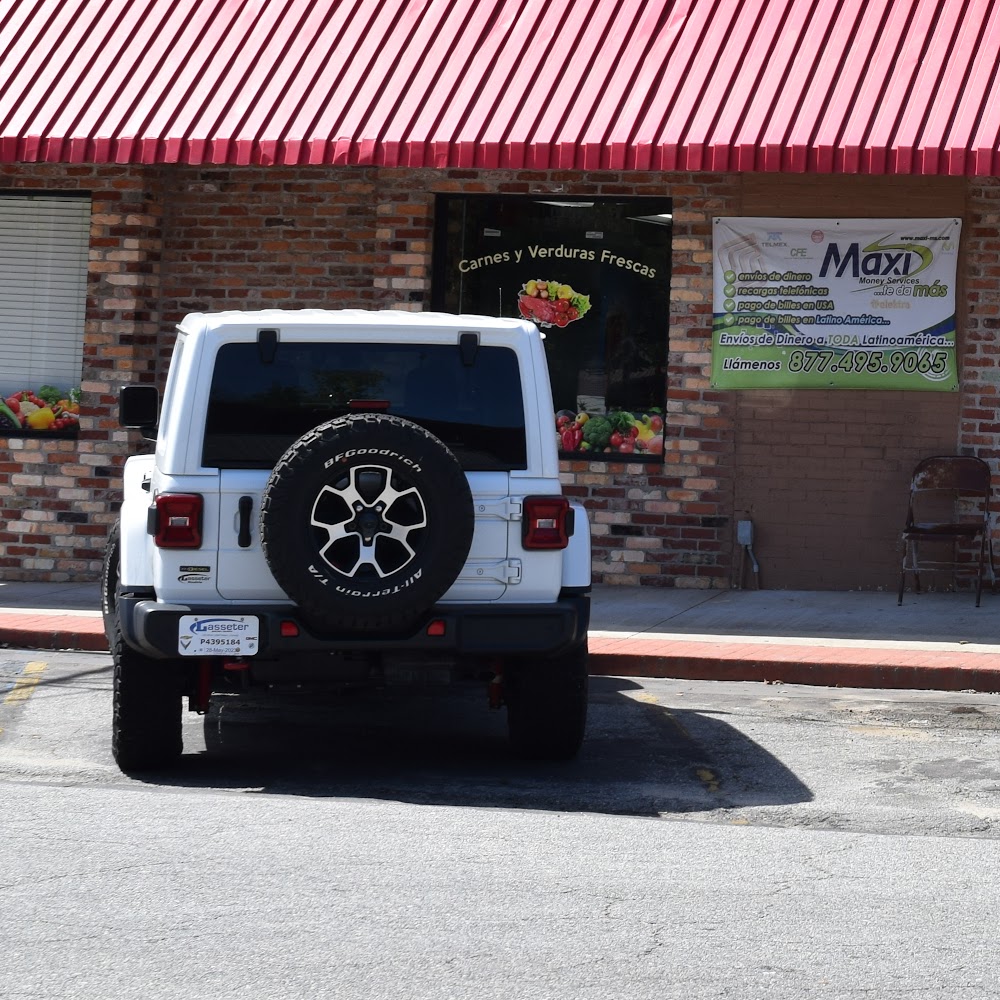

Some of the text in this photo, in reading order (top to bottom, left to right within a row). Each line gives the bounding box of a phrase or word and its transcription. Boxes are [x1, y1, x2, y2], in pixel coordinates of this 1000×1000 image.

[790, 248, 807, 256] CFE
[458, 244, 657, 278] Carnes y Verduras Frescas
[819, 242, 912, 278] Maxi
[738, 270, 812, 282] envíos de dinero
[859, 277, 920, 286] Money Services
[737, 284, 829, 297] recargas telefónicas
[895, 284, 912, 296] da
[913, 279, 948, 297] más
[738, 301, 762, 312] pago
[763, 300, 776, 310] de
[802, 301, 815, 310] en
[815, 300, 834, 310] USA
[738, 315, 762, 326] pago
[763, 314, 776, 325] de
[802, 316, 815, 325] en
[815, 315, 842, 325] Latino
[719, 333, 755, 346] Envíos
[758, 334, 773, 345] de
[777, 334, 813, 346] Dinero
[815, 337, 825, 345] a
[828, 335, 859, 345] TODA
[723, 350, 948, 373] Llámenos 877.495.9065
[324, 448, 422, 473] BFGoodrich
[308, 564, 423, 597] All-Terrain T/A
[195, 621, 249, 632] Lasseter
